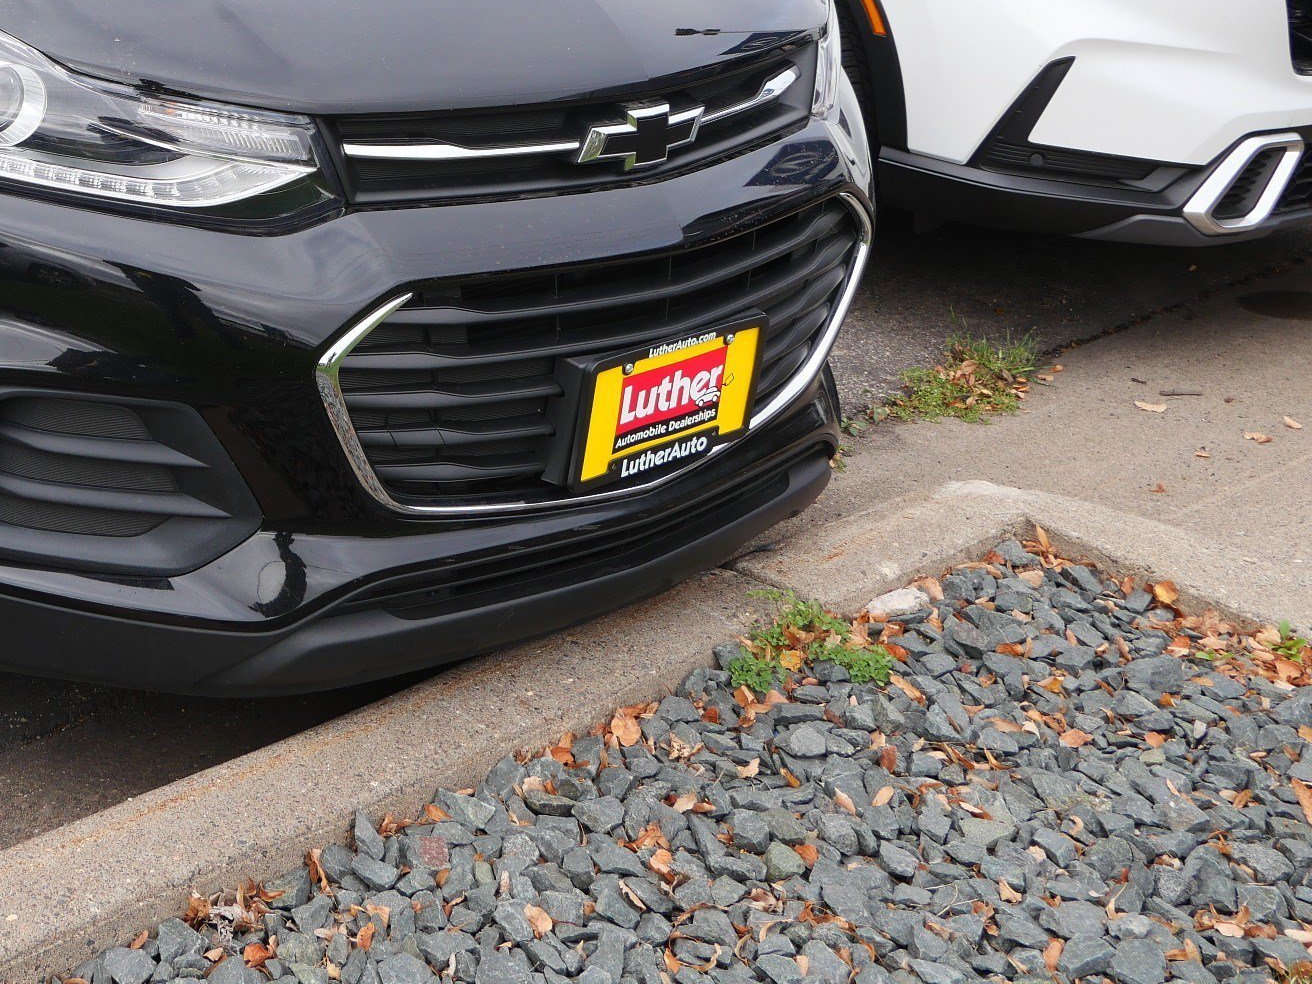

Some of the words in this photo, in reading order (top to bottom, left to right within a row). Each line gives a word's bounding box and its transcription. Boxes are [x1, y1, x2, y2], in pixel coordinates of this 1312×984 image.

[648, 331, 717, 358] LutherAuto.com
[619, 364, 724, 426] Luther
[614, 424, 667, 449] Automobile
[668, 408, 716, 433] Dealerships
[620, 435, 708, 478] LutherAuto
